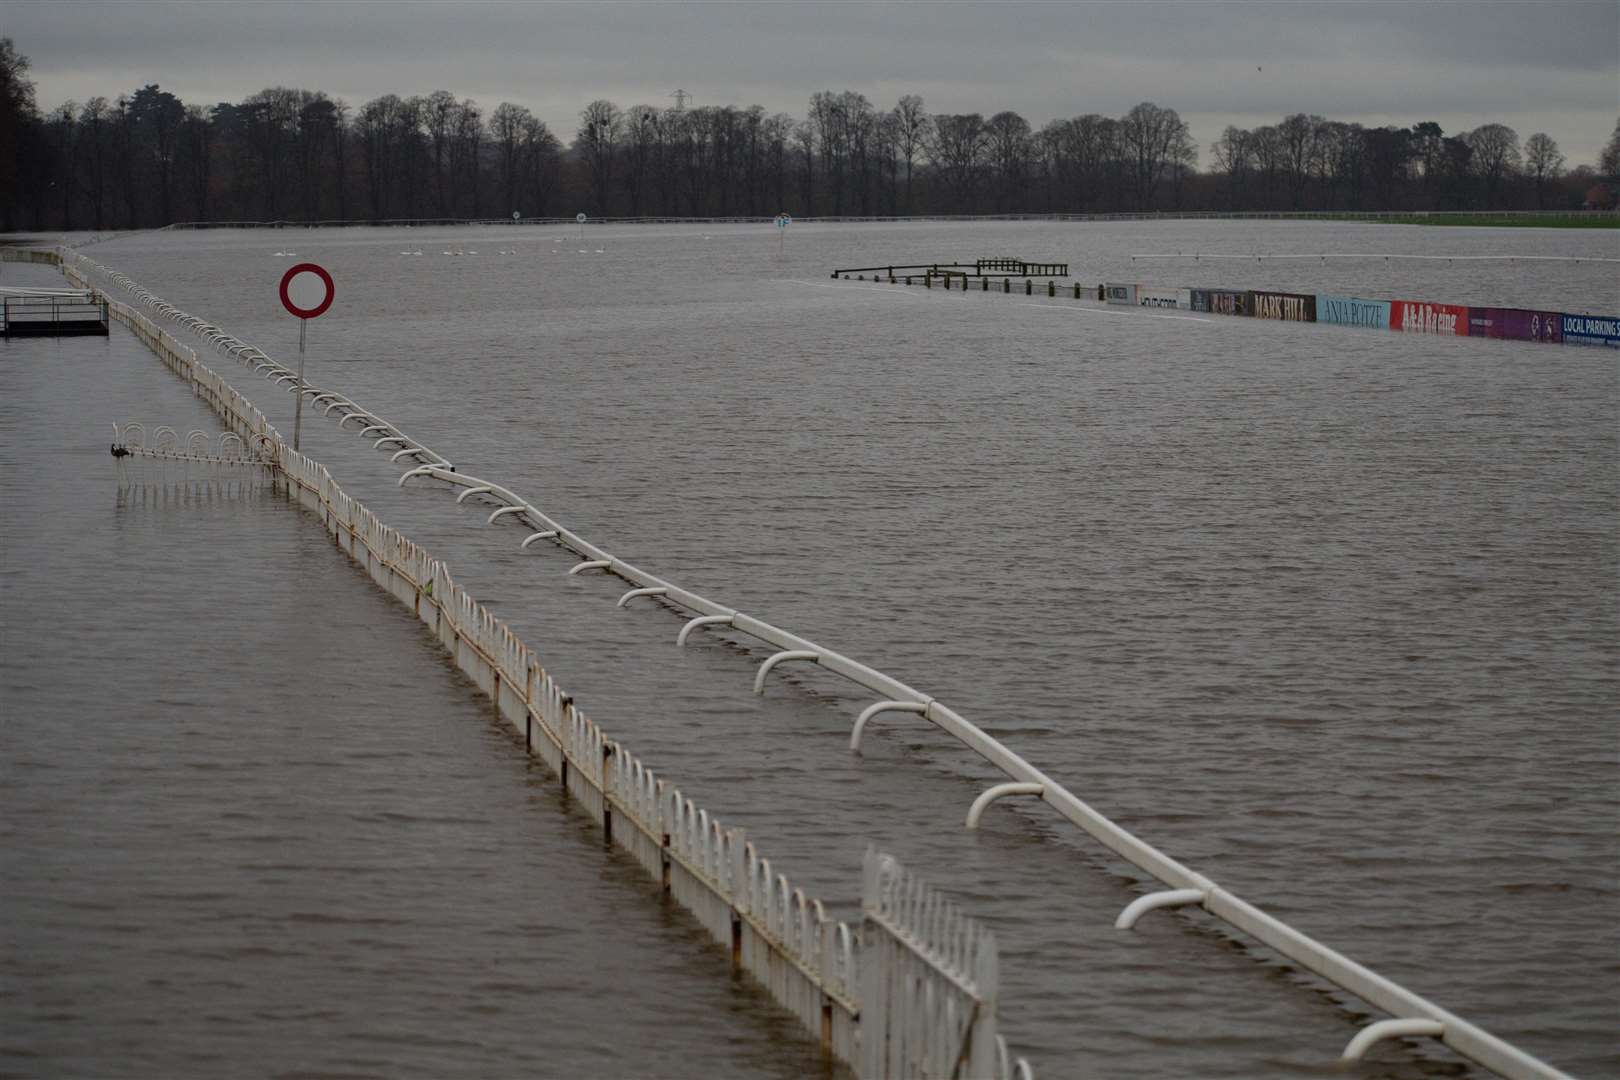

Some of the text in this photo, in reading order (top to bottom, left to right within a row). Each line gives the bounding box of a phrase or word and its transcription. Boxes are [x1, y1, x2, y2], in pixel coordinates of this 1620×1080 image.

[1255, 294, 1282, 318] MARK
[1284, 296, 1307, 320] HILL
[1402, 303, 1424, 328] A&A
[1425, 304, 1457, 331] Racing
[1563, 317, 1585, 333] LOCAL
[1585, 318, 1616, 336] PARKING
